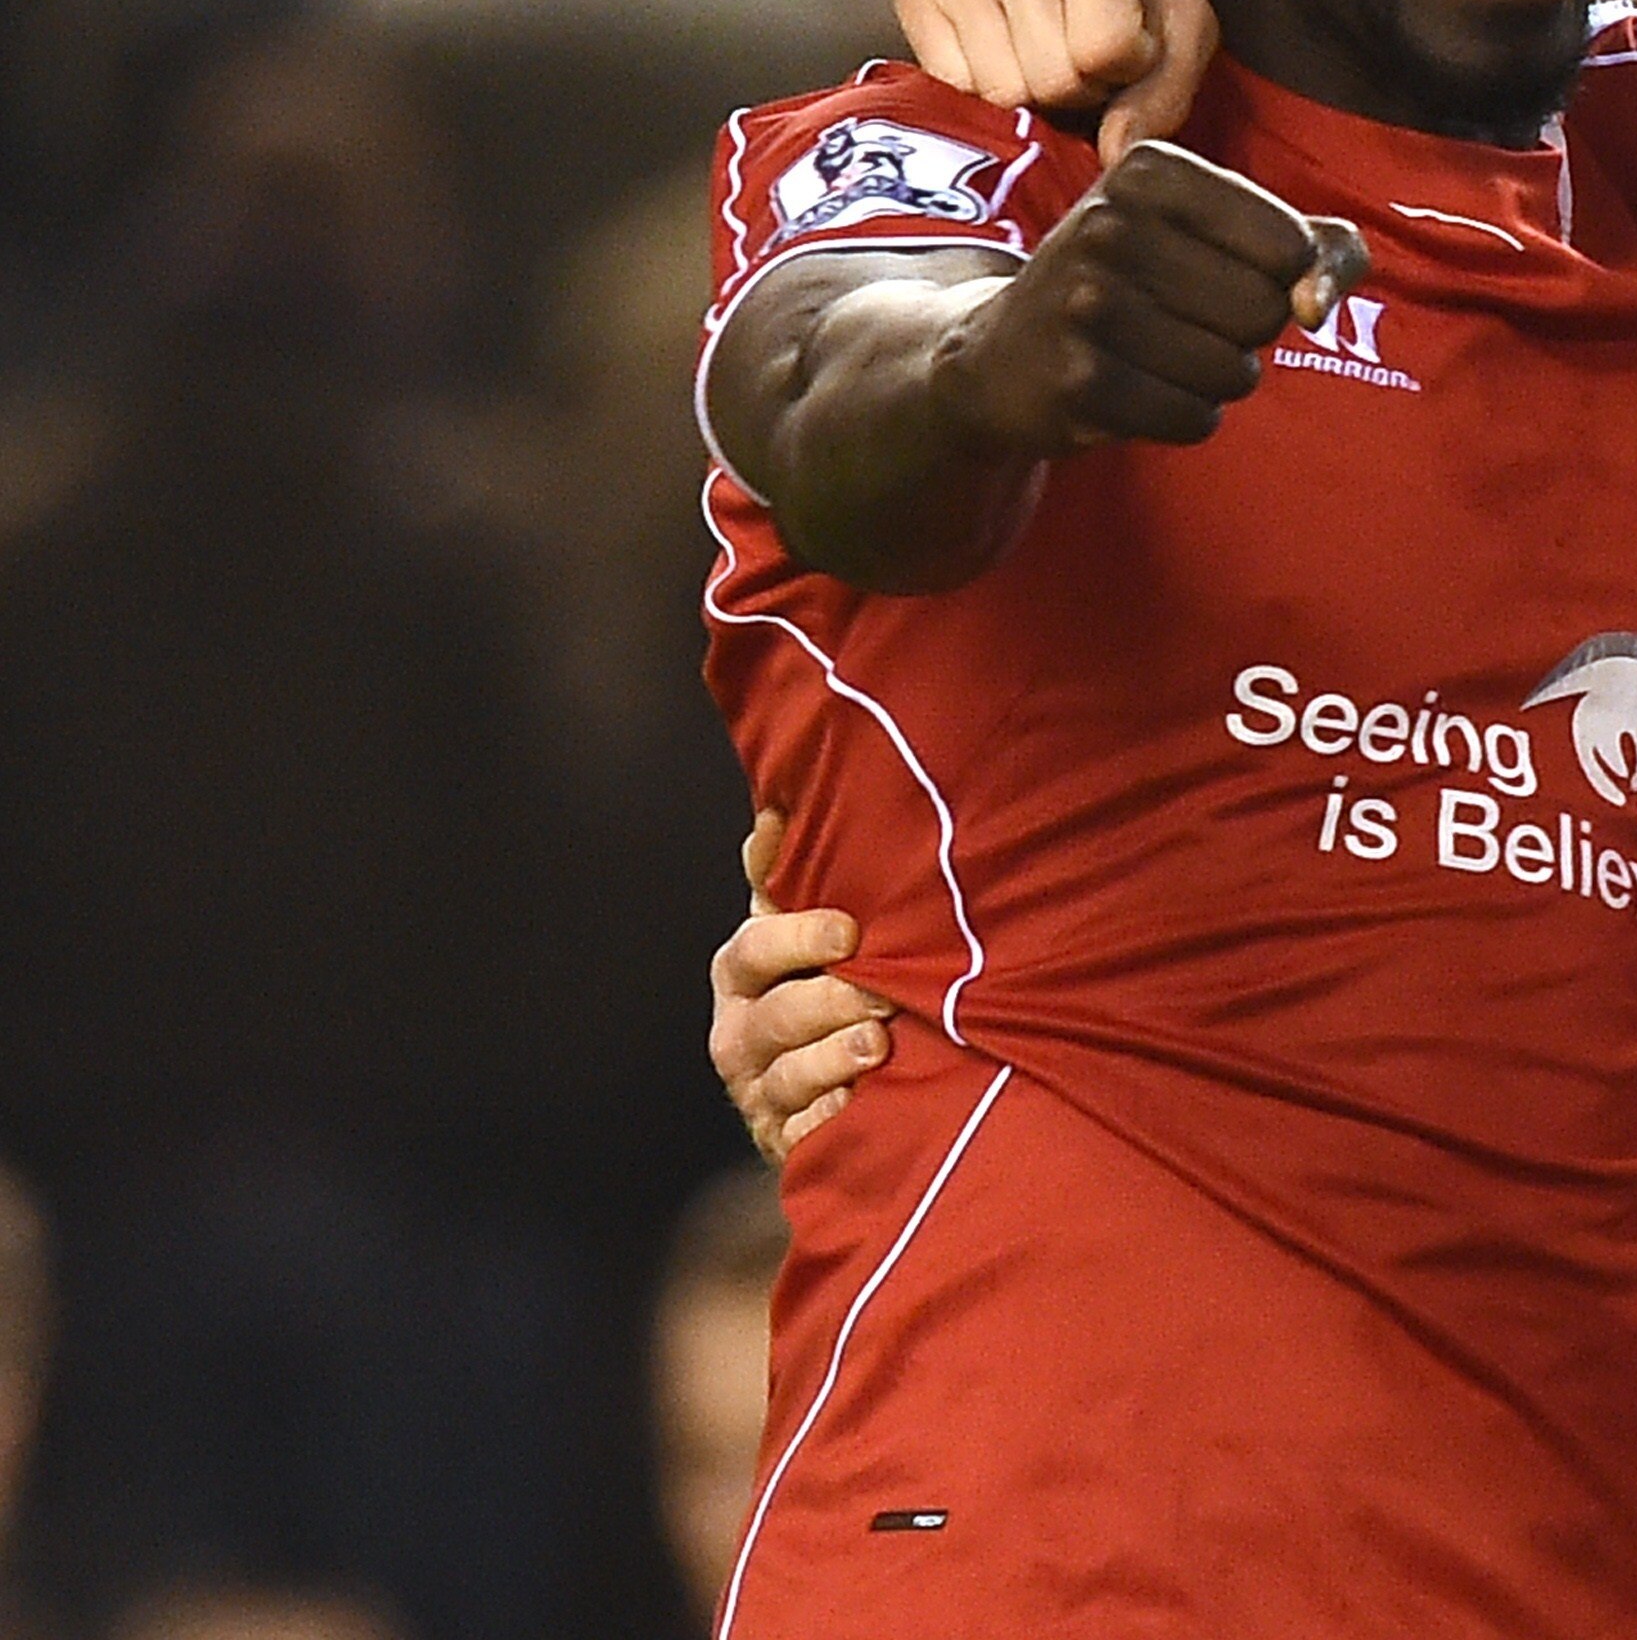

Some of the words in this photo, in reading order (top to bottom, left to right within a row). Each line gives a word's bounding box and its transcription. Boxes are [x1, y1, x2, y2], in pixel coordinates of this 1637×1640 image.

[1273, 346, 1410, 391] WARRIOR
[1226, 665, 1538, 796] Seeing
[1318, 775, 1398, 860] is
